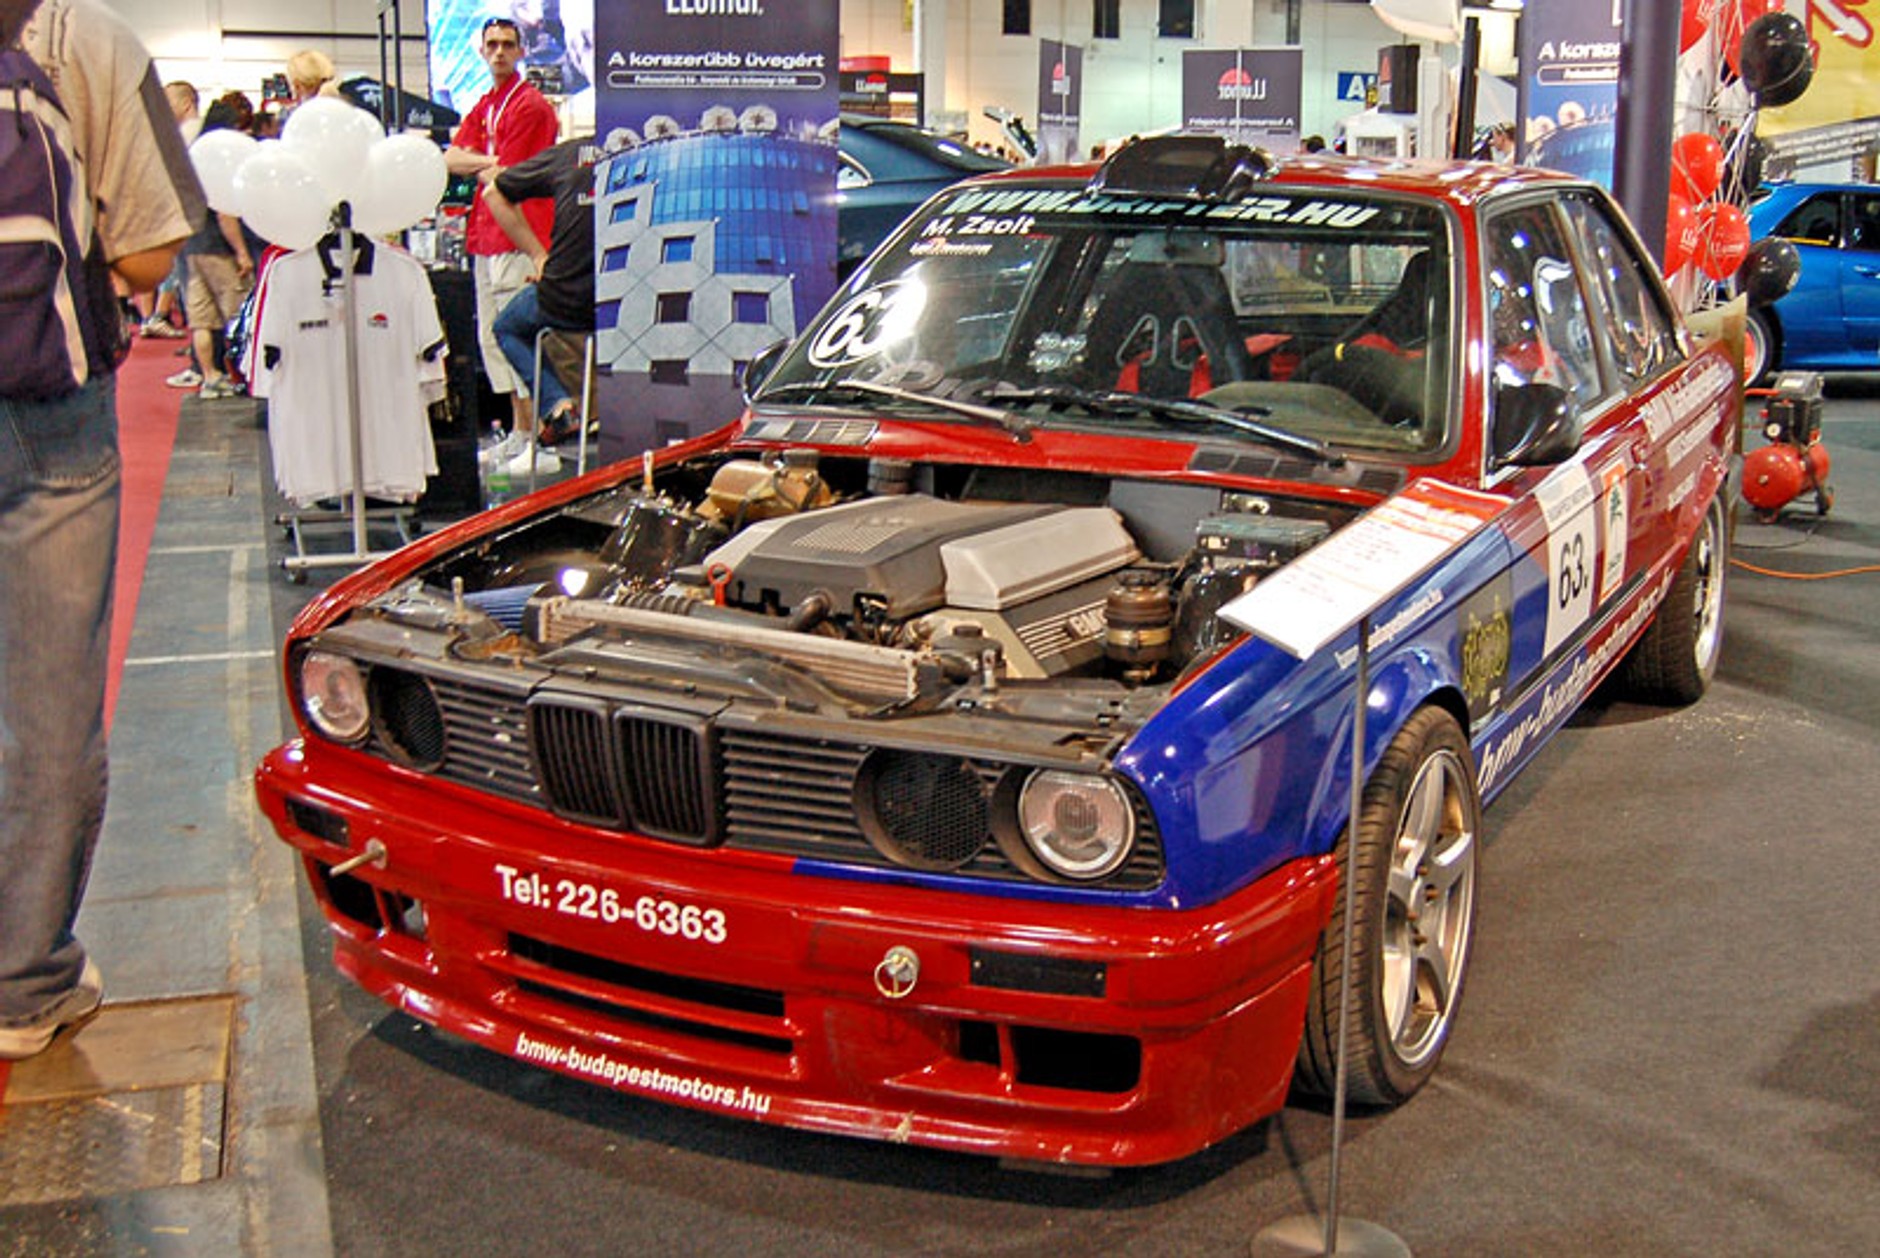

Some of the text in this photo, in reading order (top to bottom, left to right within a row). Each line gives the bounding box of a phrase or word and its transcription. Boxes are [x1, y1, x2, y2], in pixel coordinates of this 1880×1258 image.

[608, 53, 625, 67] A
[921, 214, 1035, 238] M. Zsolt
[495, 864, 727, 944] Tel: 226-6363
[515, 1032, 771, 1113] bmw-budapestmotors.hu
